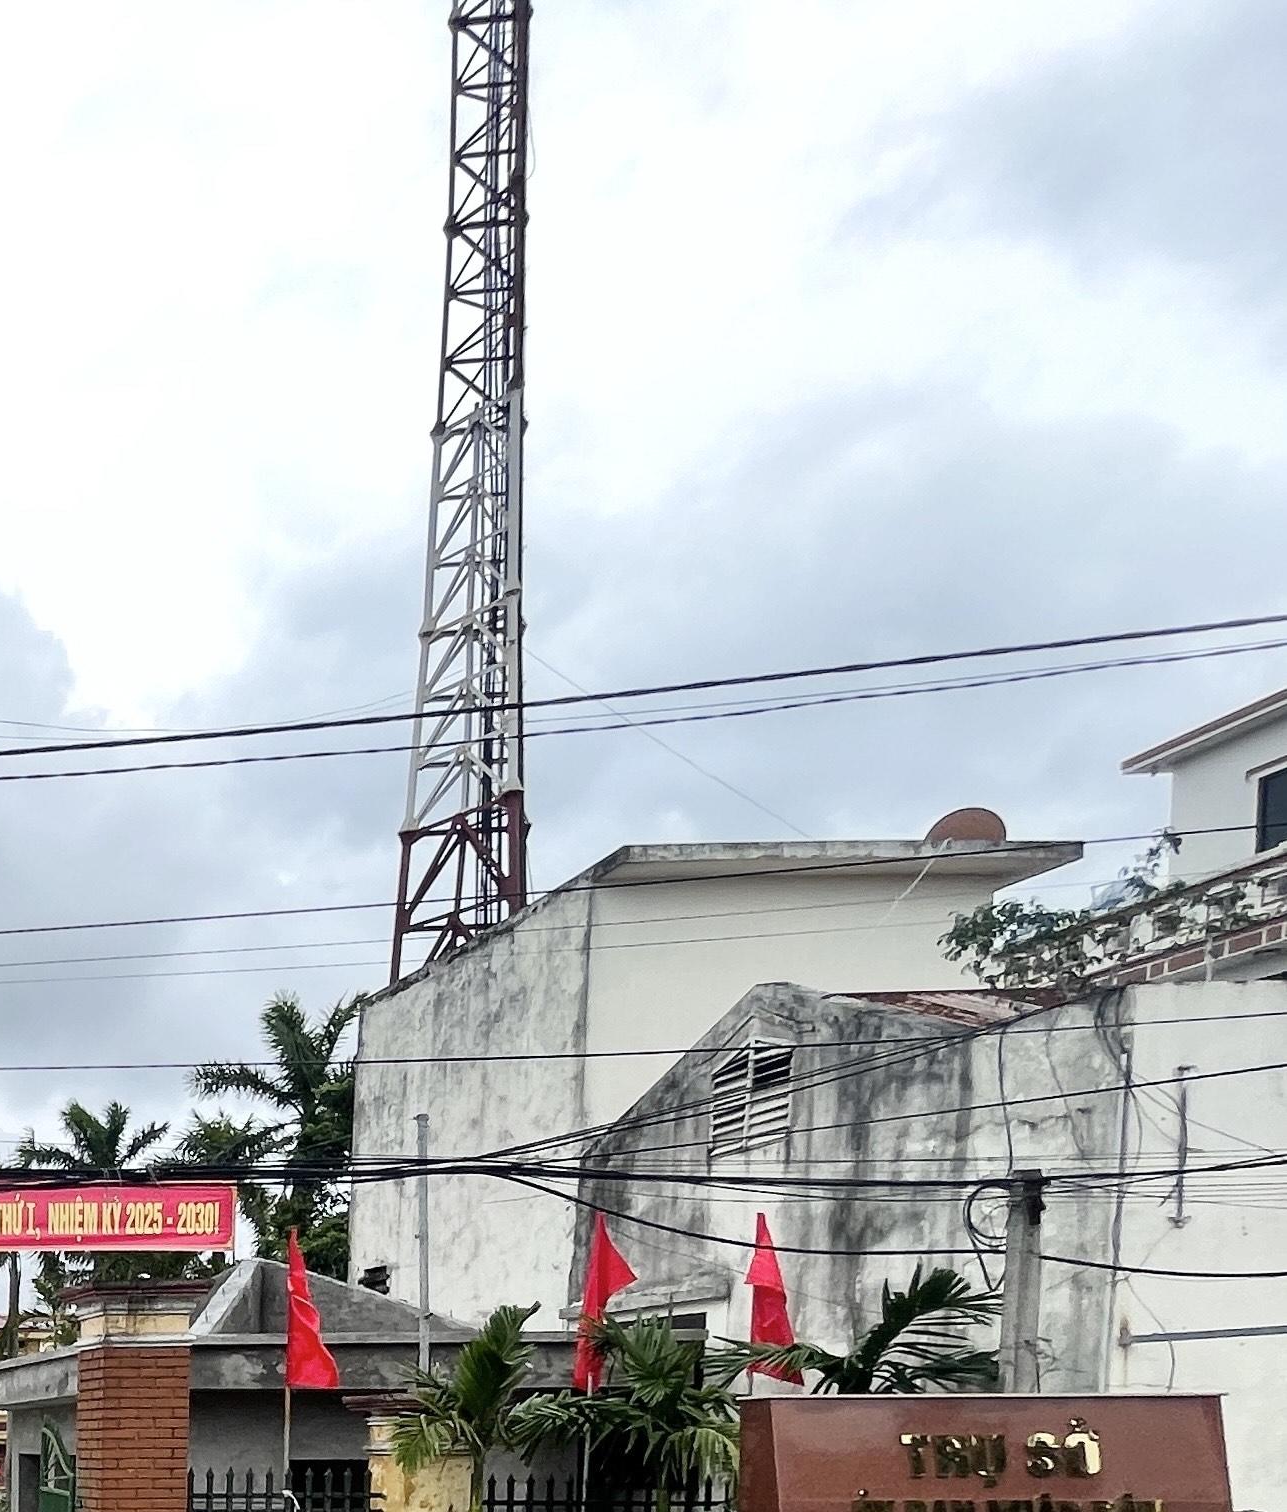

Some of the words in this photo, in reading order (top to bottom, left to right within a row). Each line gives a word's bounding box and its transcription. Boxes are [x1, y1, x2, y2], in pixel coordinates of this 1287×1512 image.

[48, 1195, 99, 1242] NHIỆM
[125, 1201, 163, 1235] 2025
[899, 1433, 1007, 1488] TRỤ
[1025, 1417, 1103, 1478] SỞ
